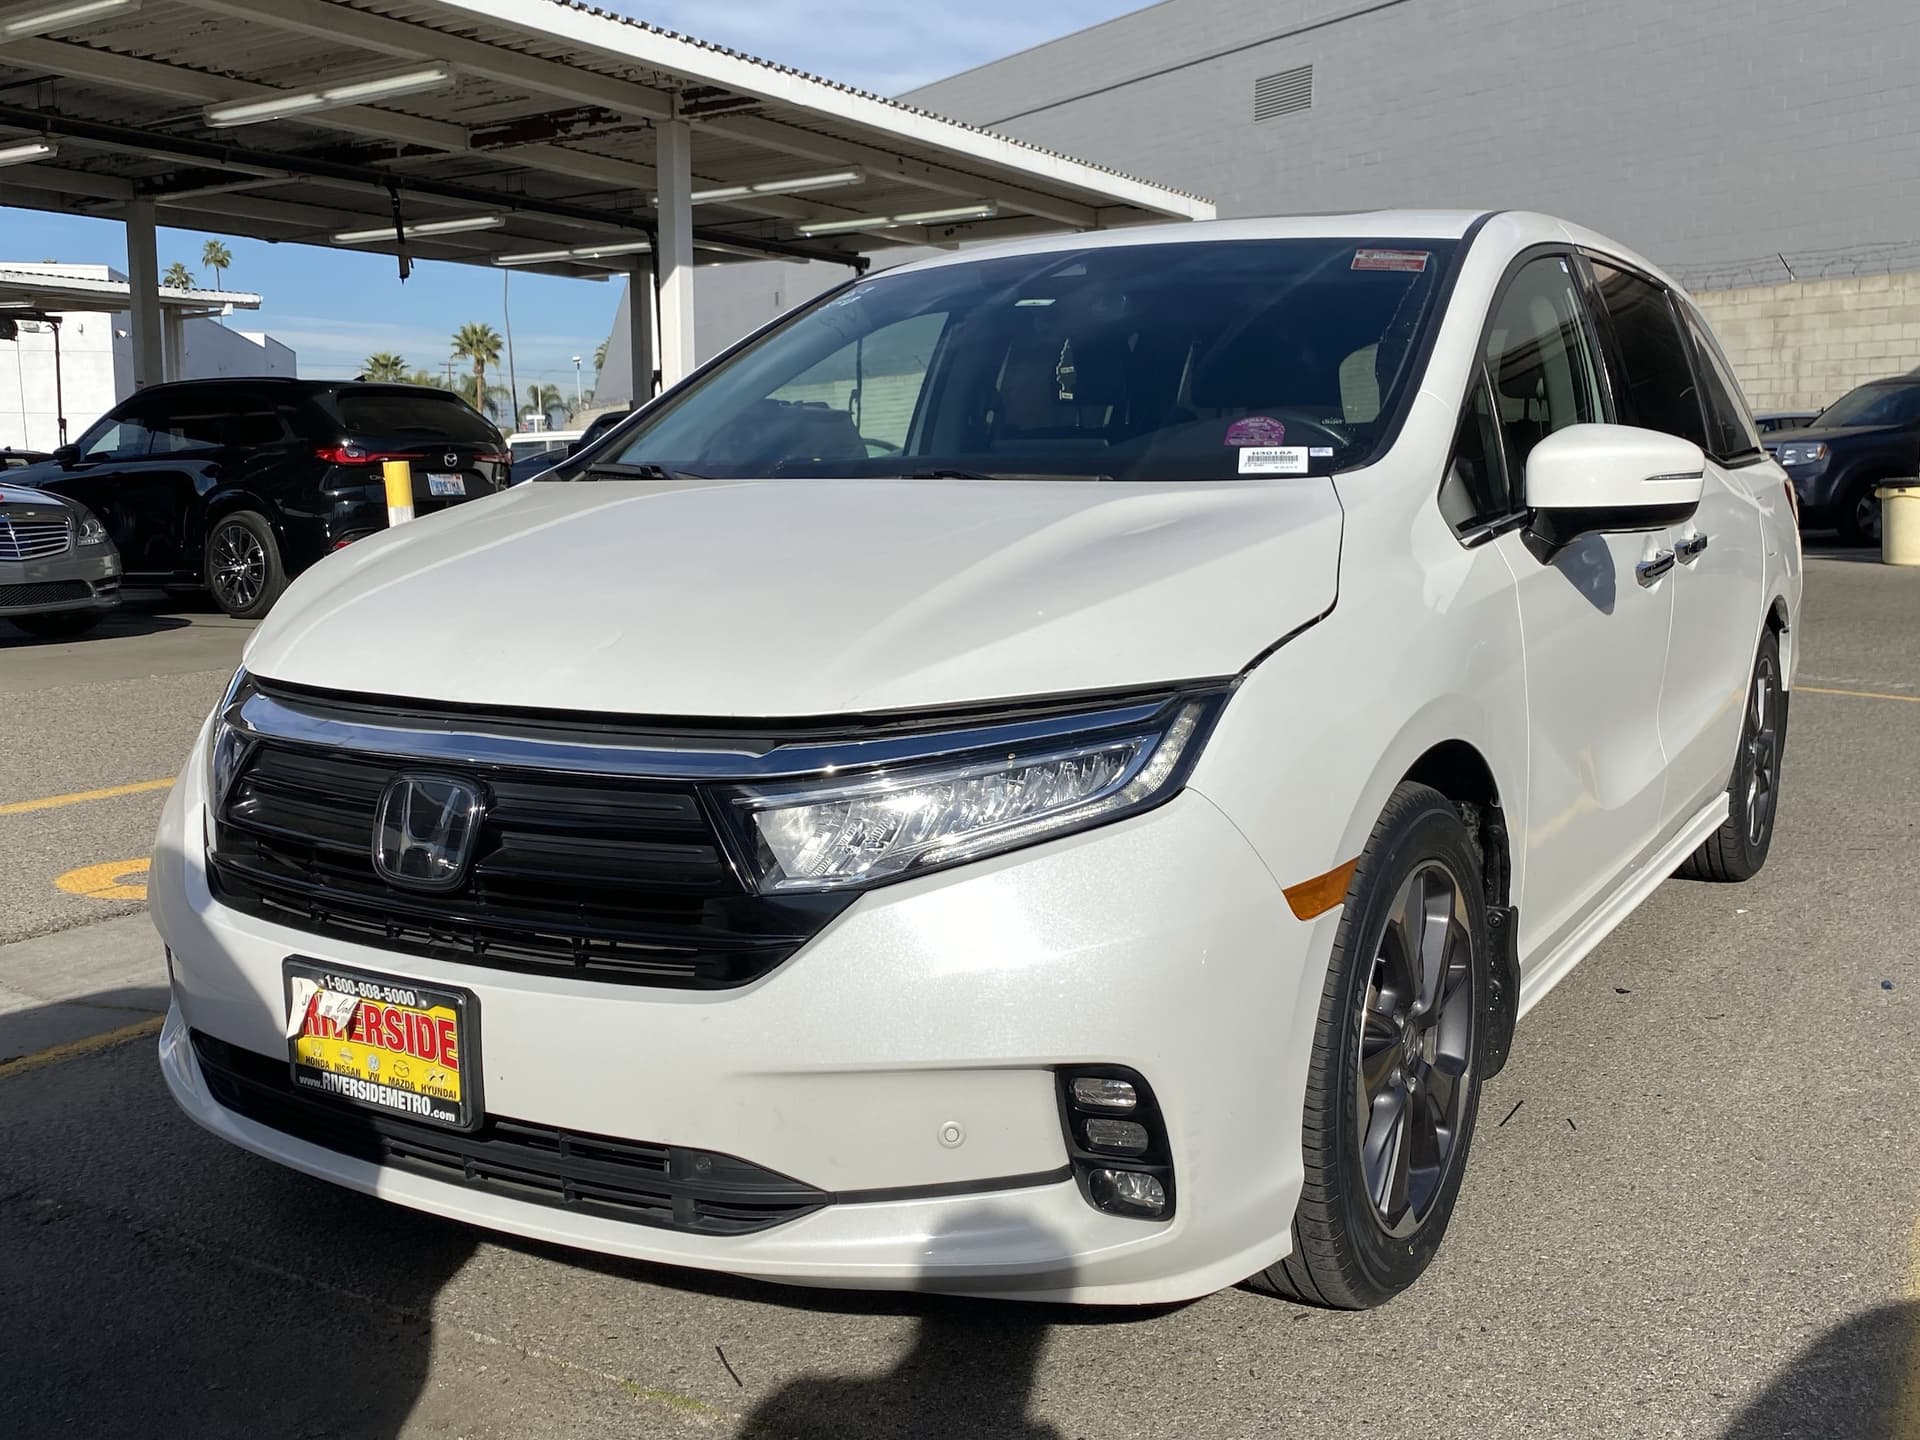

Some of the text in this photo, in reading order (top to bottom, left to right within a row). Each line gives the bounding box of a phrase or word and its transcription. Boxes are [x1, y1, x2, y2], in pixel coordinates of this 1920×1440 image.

[324, 974, 415, 1006] 1-800-808-5000
[305, 1055, 330, 1070] HONDA
[334, 1064, 361, 1079] NISSAN
[368, 1071, 380, 1082] VW
[388, 1076, 415, 1090] MAZDA
[299, 1072, 455, 1122] www.RIVERSIDEMETRO.com
[421, 1084, 456, 1099] HYUNDAI
